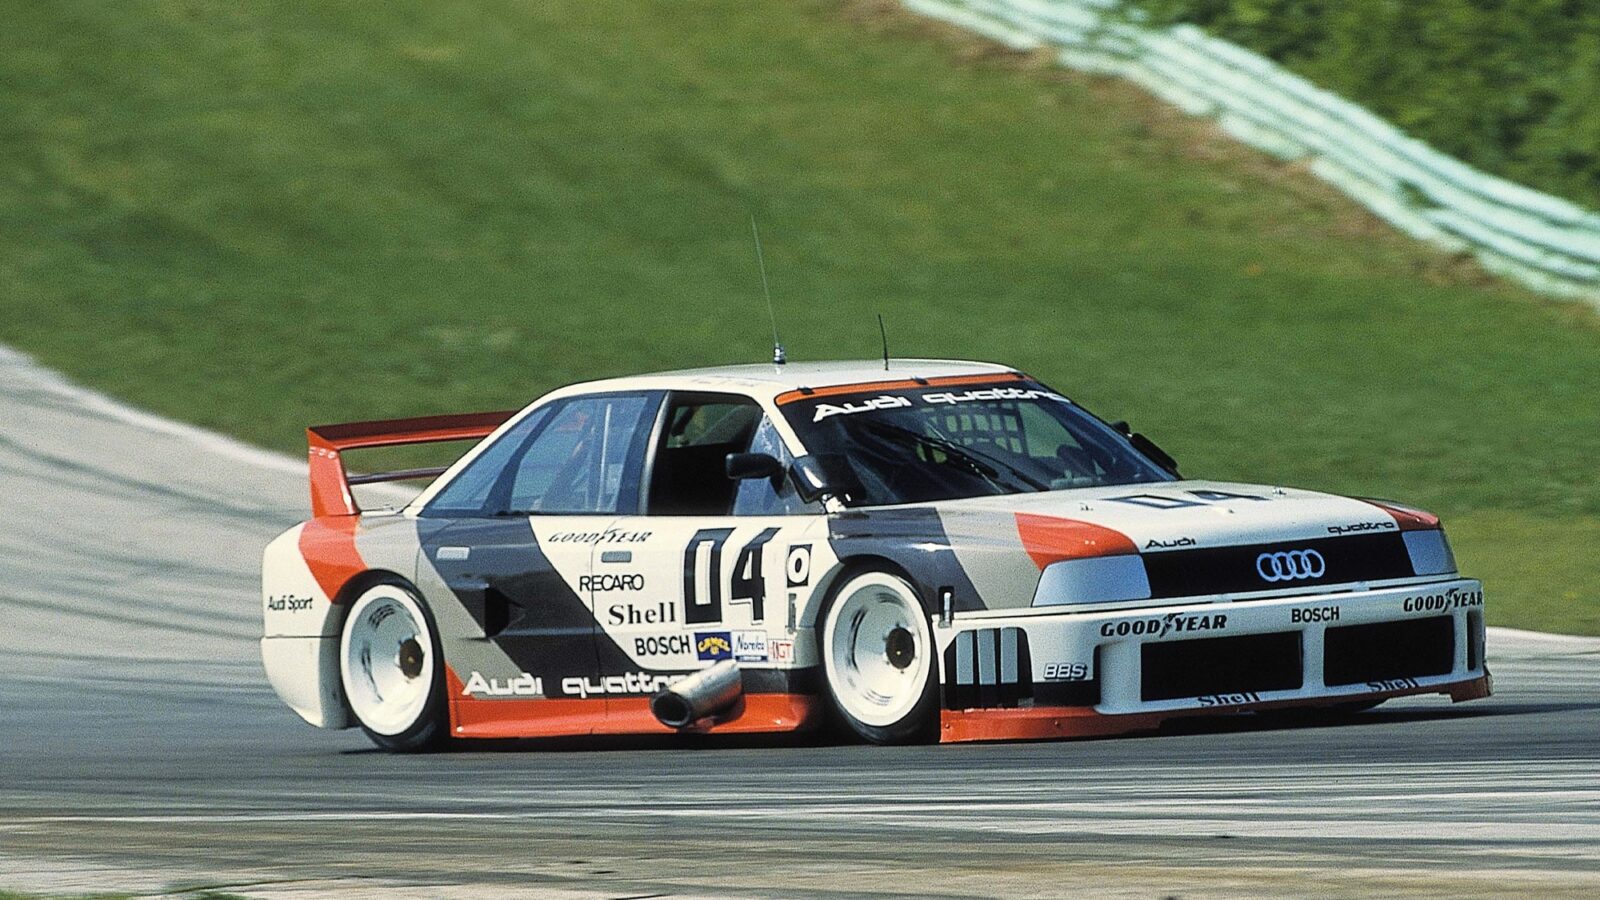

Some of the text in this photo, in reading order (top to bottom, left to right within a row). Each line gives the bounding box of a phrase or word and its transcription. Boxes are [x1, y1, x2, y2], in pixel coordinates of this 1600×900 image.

[813, 389, 1070, 422] Audi quattro
[1328, 522, 1394, 534] quattro
[1146, 537, 1196, 549] Audi
[580, 574, 644, 592] RECARO
[683, 527, 782, 624] 04
[268, 595, 313, 613] Audi Sport
[608, 602, 676, 626] Shell
[1291, 606, 1340, 623] BOSCH
[1101, 612, 1227, 638] GOODYEAR
[635, 635, 690, 656] BOSCH
[1043, 663, 1087, 679] BBS
[462, 672, 543, 695] Audi
[1365, 677, 1418, 692] Shell
[1198, 692, 1259, 707] Shell
